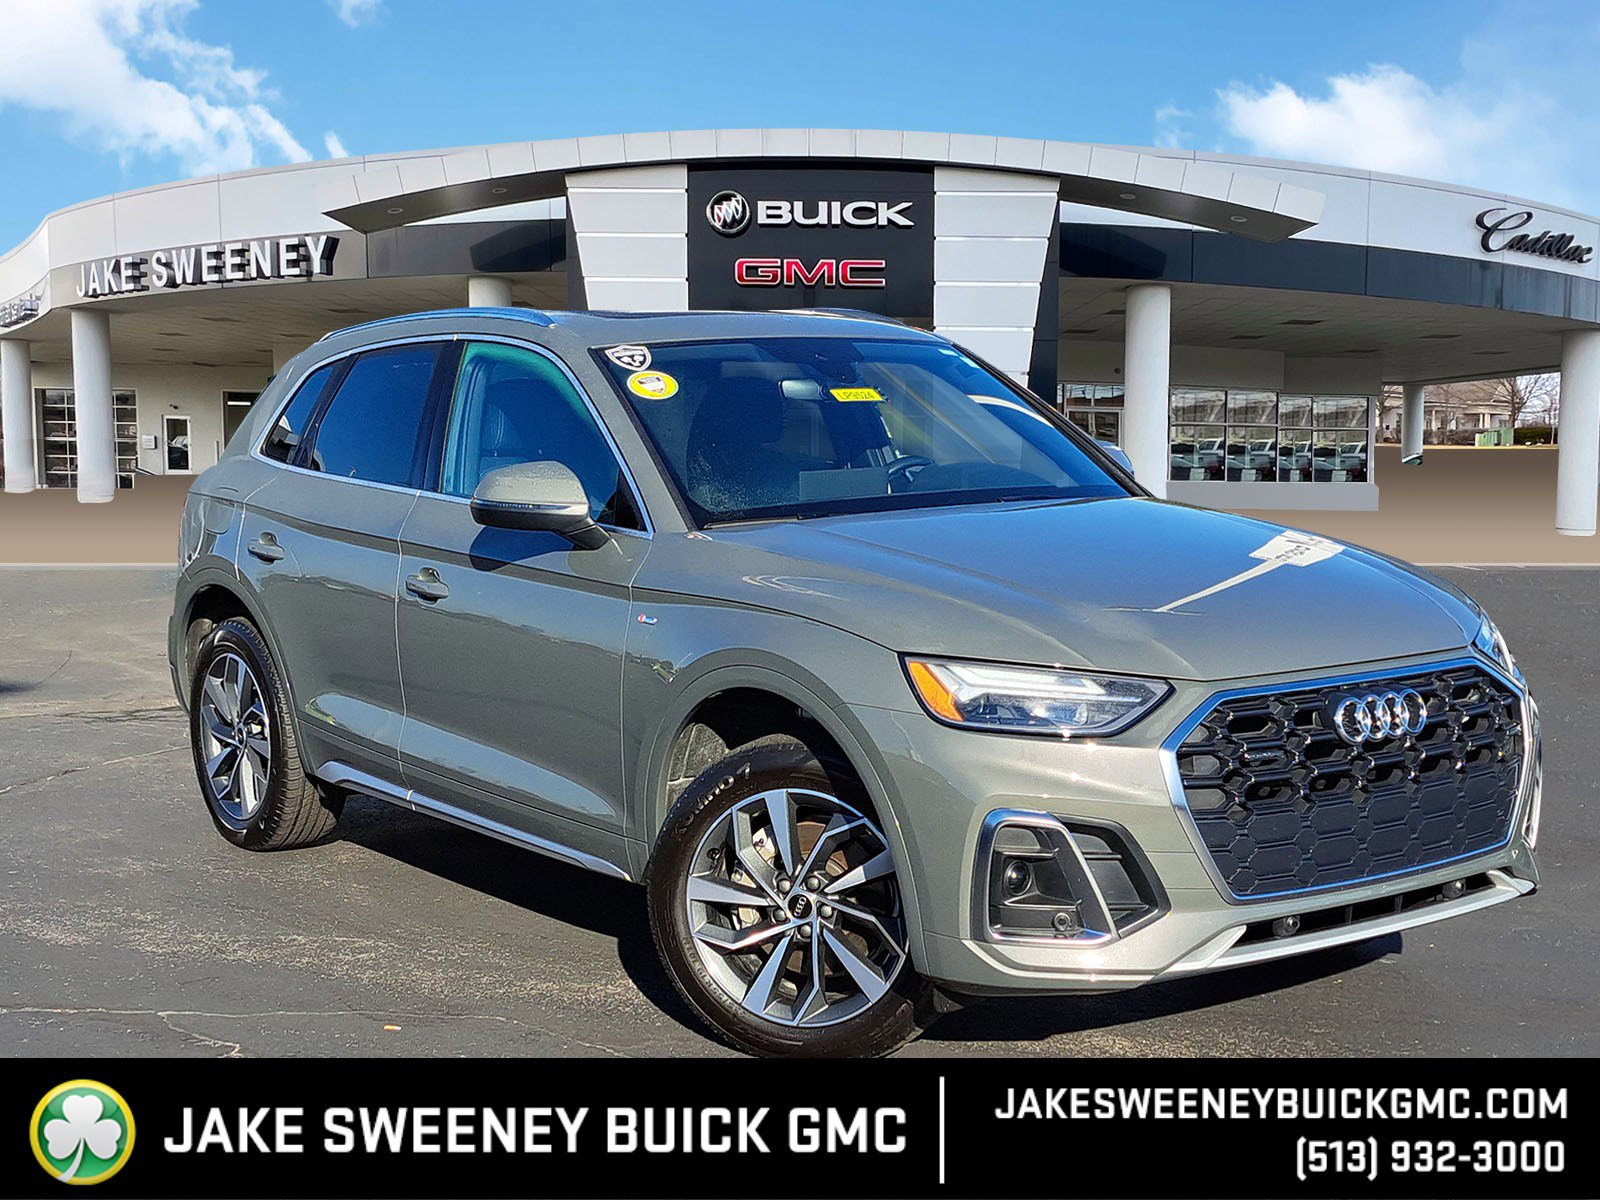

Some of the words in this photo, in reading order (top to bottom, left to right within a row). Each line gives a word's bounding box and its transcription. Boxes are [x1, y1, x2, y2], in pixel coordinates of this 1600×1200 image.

[757, 200, 915, 226] BUICK
[1475, 207, 1593, 263] Cadillac
[76, 255, 136, 297] JAKE
[151, 234, 330, 288] SWEENEY
[734, 258, 886, 286] GMC
